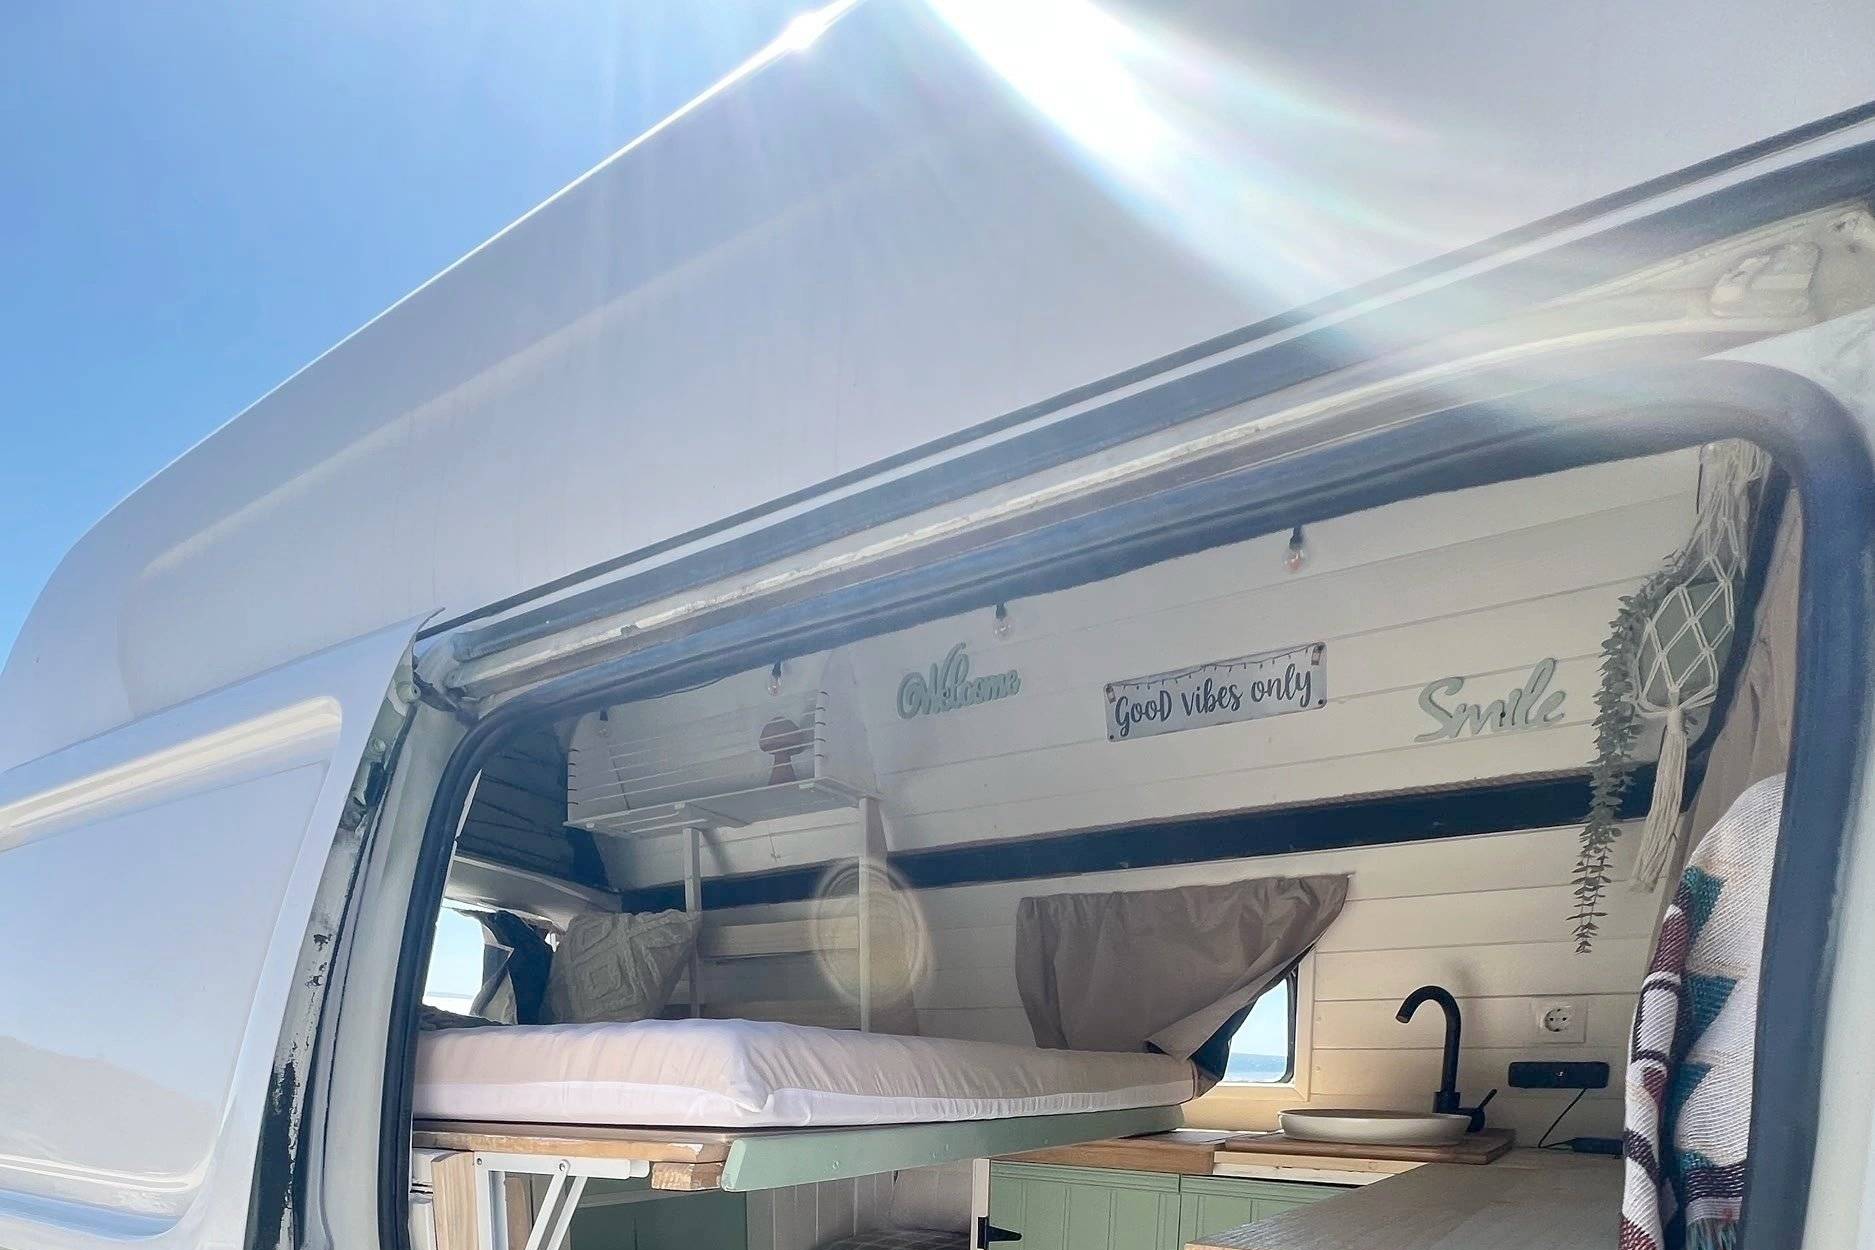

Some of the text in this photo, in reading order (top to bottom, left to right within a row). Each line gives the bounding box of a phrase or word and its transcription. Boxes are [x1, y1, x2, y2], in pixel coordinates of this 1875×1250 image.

[897, 641, 1021, 719] Welcome
[1181, 678, 1243, 717] vibes
[1251, 663, 1311, 708] only
[1414, 658, 1566, 743] Smile
